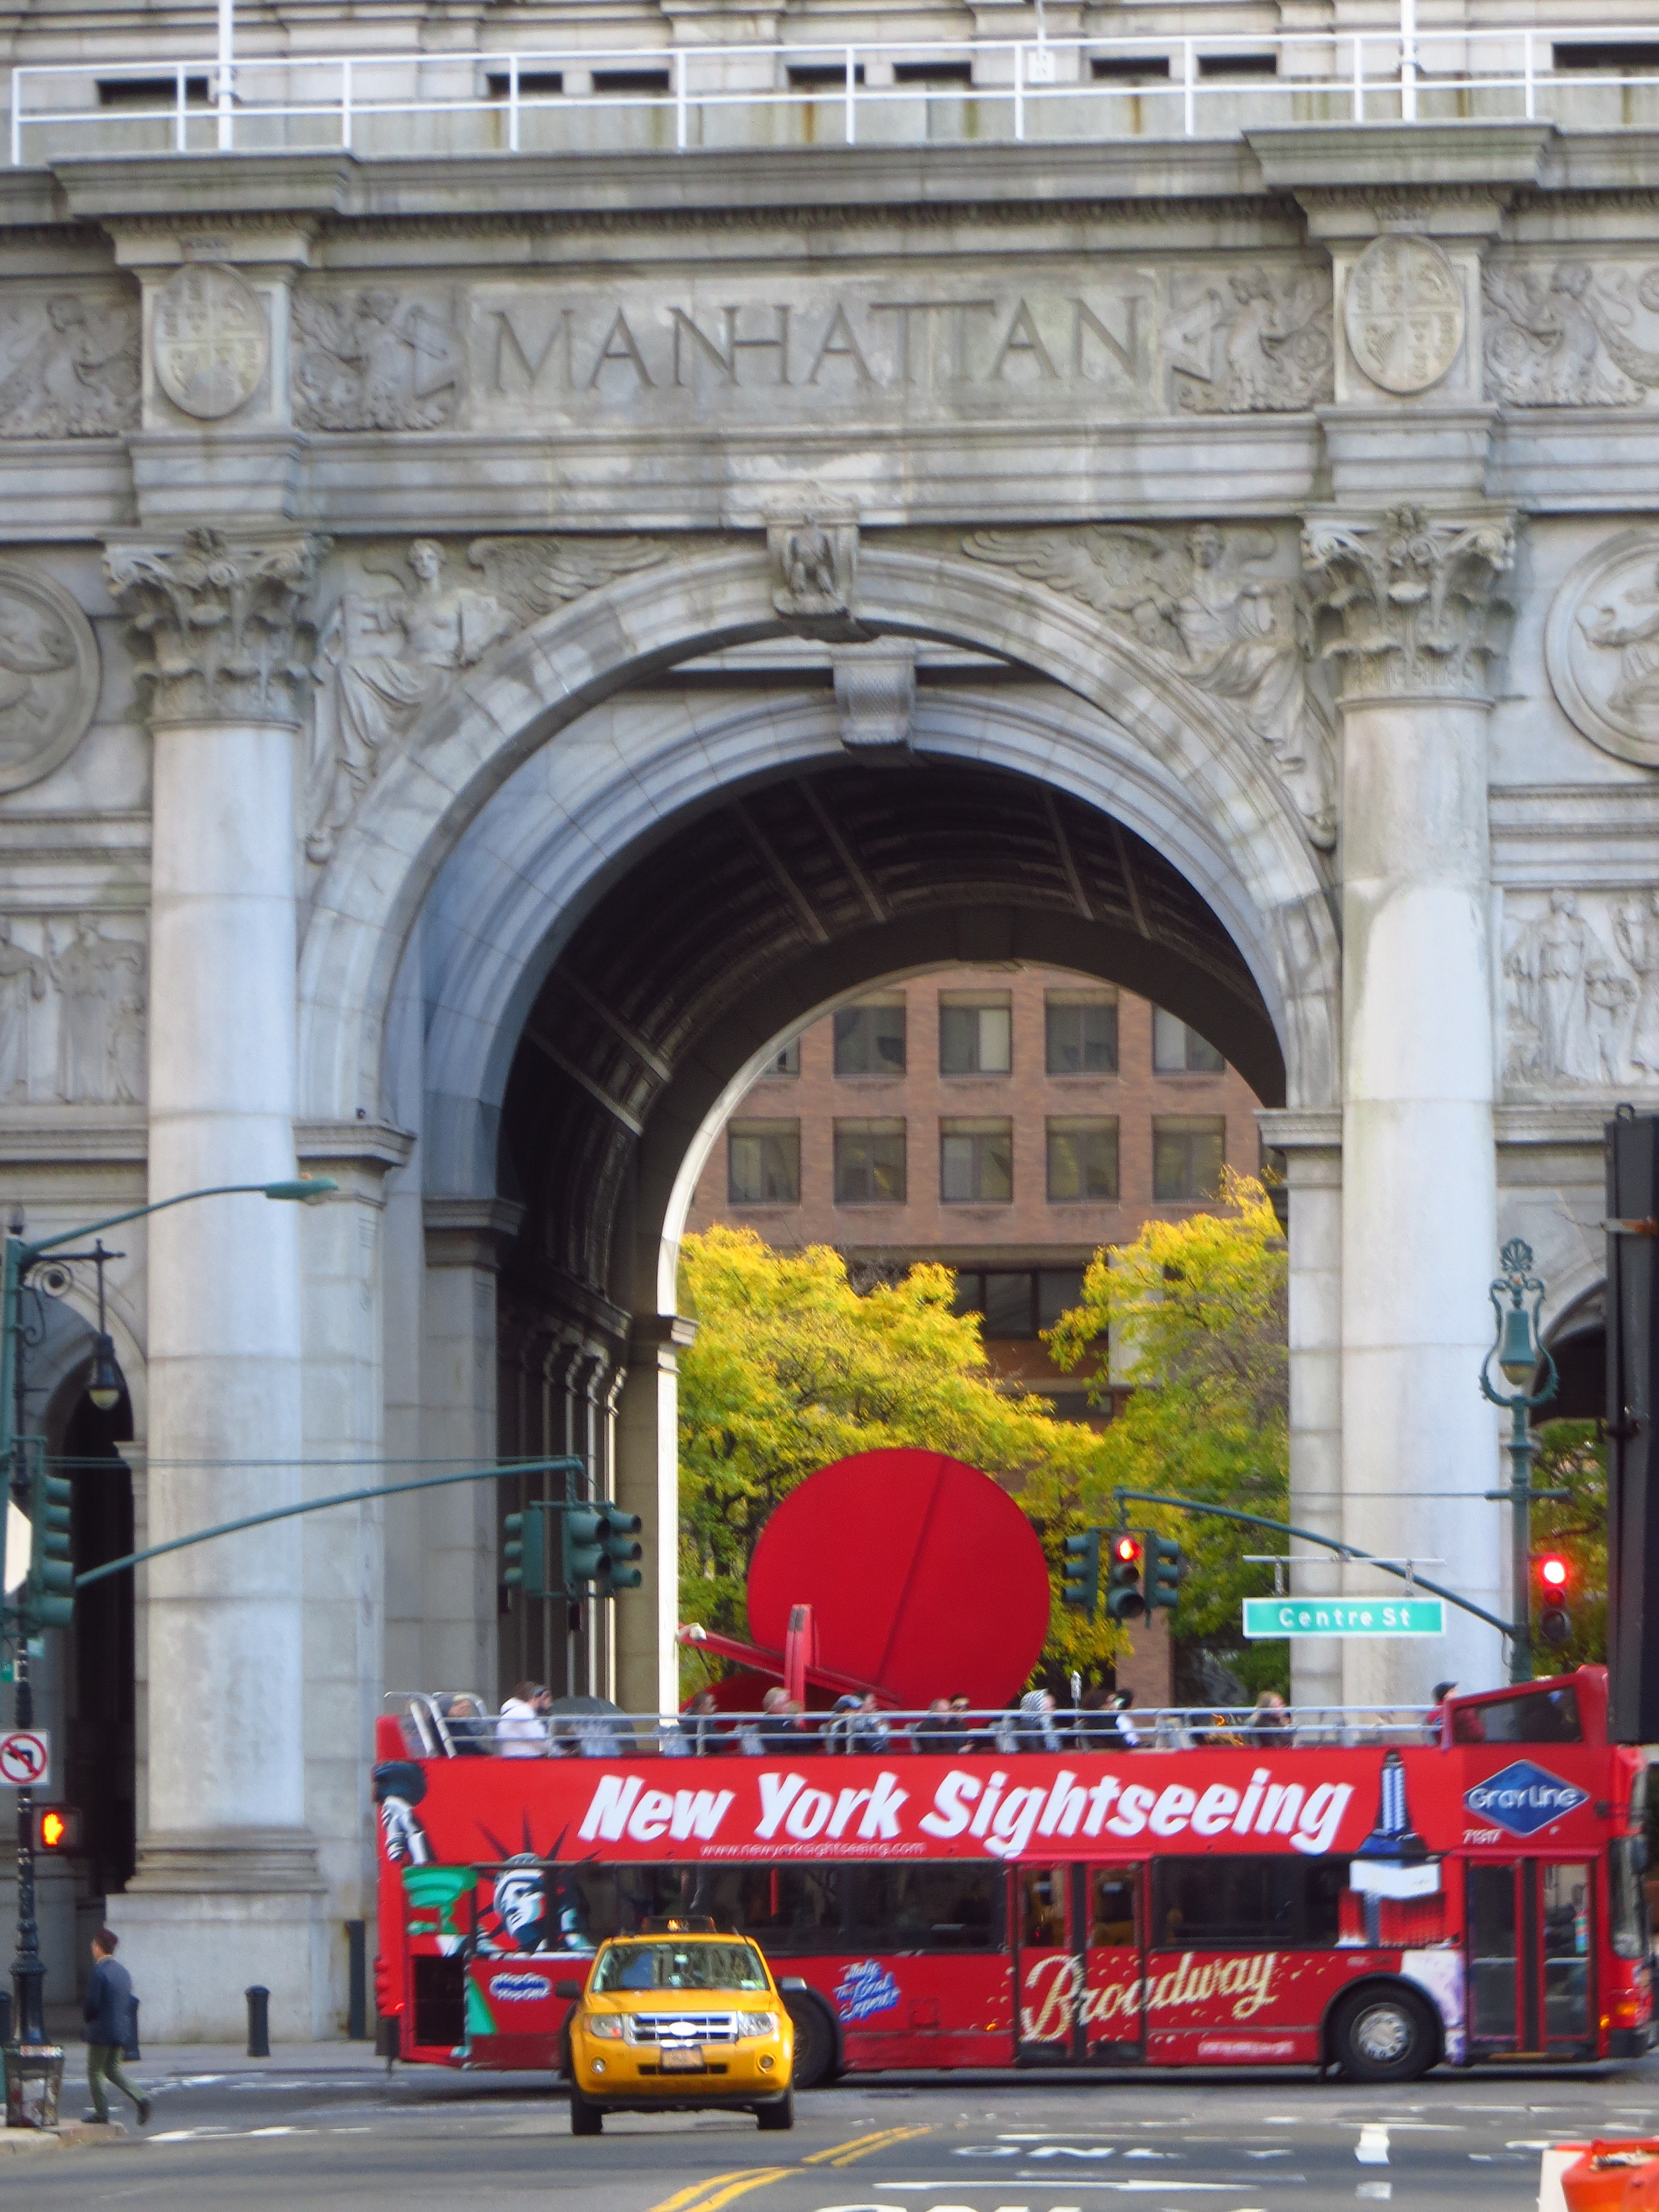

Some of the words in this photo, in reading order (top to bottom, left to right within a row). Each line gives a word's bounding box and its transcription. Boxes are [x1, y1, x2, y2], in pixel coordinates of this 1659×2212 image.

[489, 296, 1141, 393] MANHATTAN
[1278, 1607, 1373, 1628] Centre
[1382, 1607, 1410, 1628] St
[577, 1774, 736, 1842] New
[753, 1770, 910, 1840] York
[918, 1767, 1354, 1858] Sightseeing
[1019, 1952, 1279, 2043] Broadway
